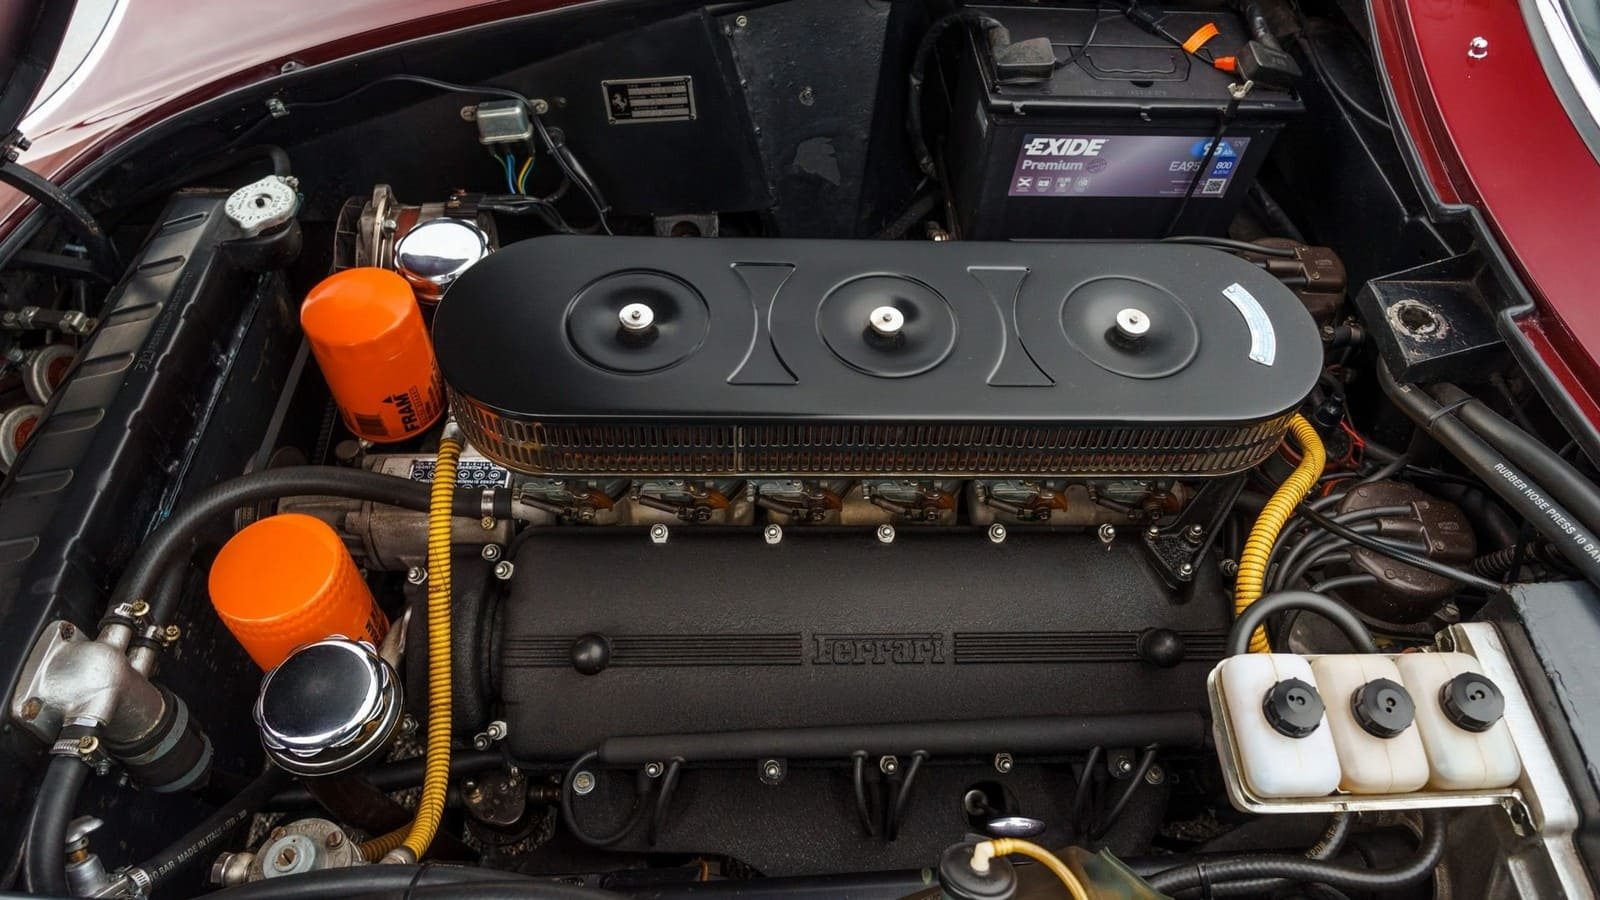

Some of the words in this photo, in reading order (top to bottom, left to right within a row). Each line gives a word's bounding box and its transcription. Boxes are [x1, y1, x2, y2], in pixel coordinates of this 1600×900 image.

[1024, 138, 1105, 156] EXIDE
[1021, 159, 1083, 171] Premium
[1169, 161, 1203, 172] EA95
[1215, 161, 1233, 170] 800
[393, 392, 418, 432] FRAM
[1494, 463, 1527, 491] RUBBER
[1524, 488, 1549, 510] HOSE
[1546, 508, 1577, 535] PRESS
[1573, 534, 1586, 545] 10
[812, 633, 945, 665] Ferrari
[148, 871, 159, 882] 10
[158, 860, 175, 875] BAR
[177, 844, 199, 863] MADE
[197, 839, 207, 849] IN
[204, 828, 223, 843] ITALY
